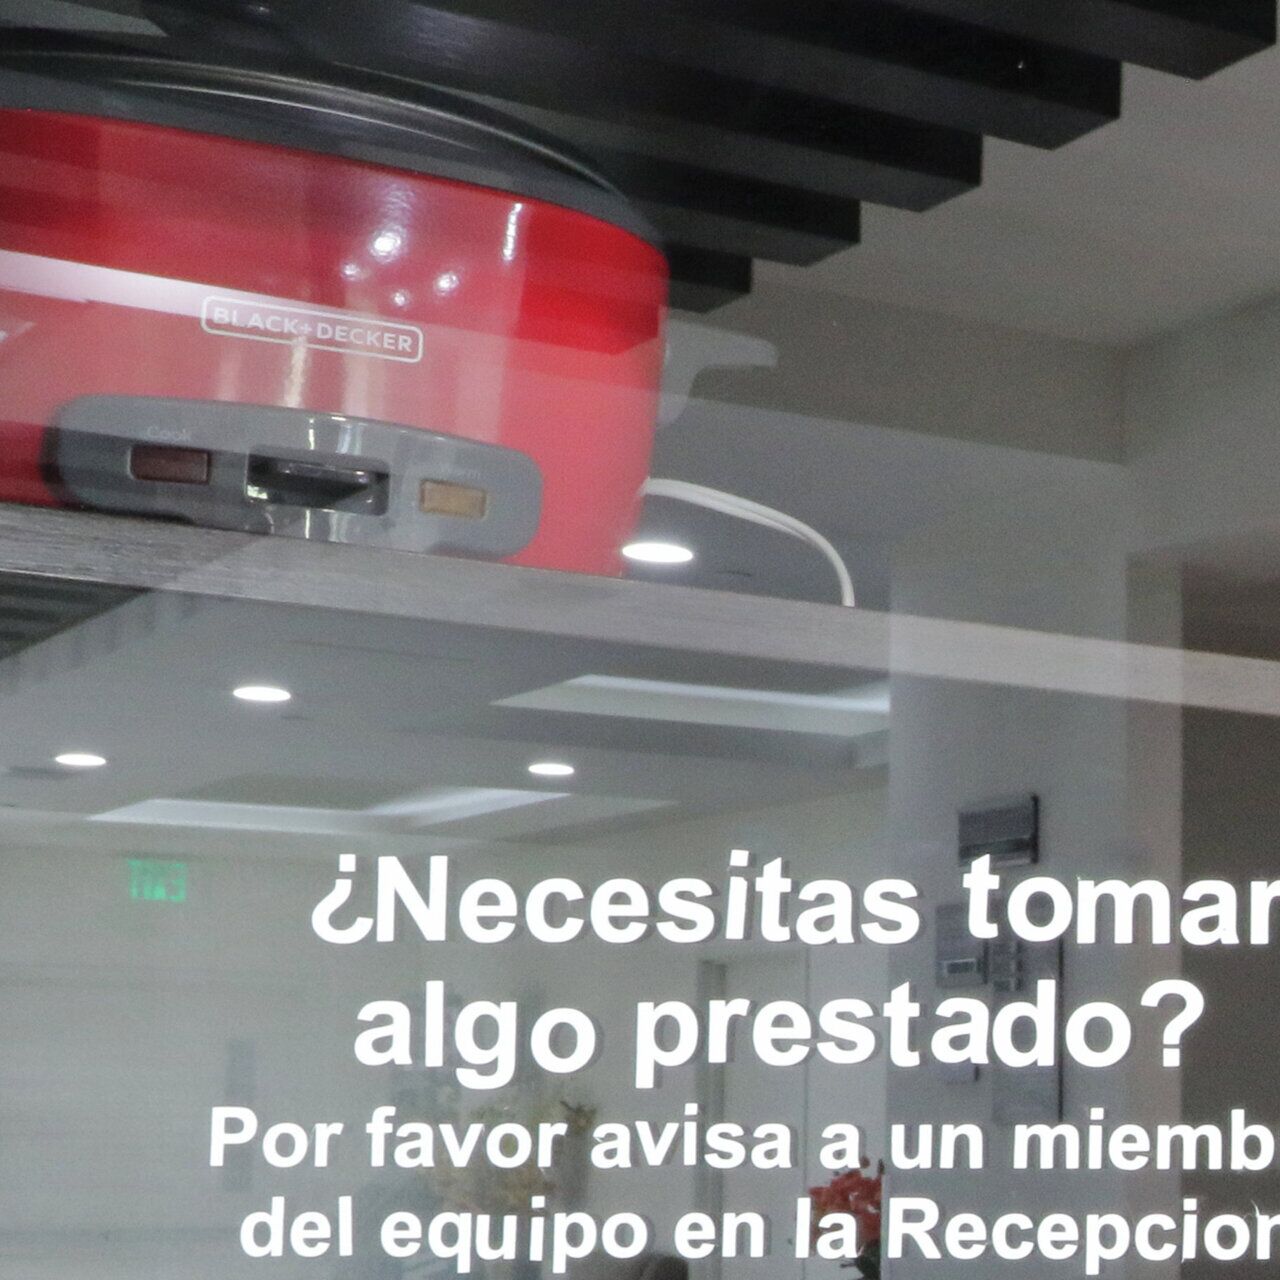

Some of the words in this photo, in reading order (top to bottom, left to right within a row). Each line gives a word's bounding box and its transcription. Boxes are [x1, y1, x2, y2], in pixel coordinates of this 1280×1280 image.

[310, 848, 921, 946] ¿Necesitas
[353, 979, 596, 1091] algo
[634, 978, 1205, 1091] prestado?
[209, 1105, 345, 1169] Por
[365, 1105, 569, 1169] favor
[590, 1102, 792, 1170] avisa
[818, 1122, 861, 1170] a
[890, 1123, 984, 1170] un
[239, 1194, 354, 1258] del
[379, 1195, 648, 1275] equipo
[673, 1211, 765, 1260] en
[794, 1196, 859, 1260] la
